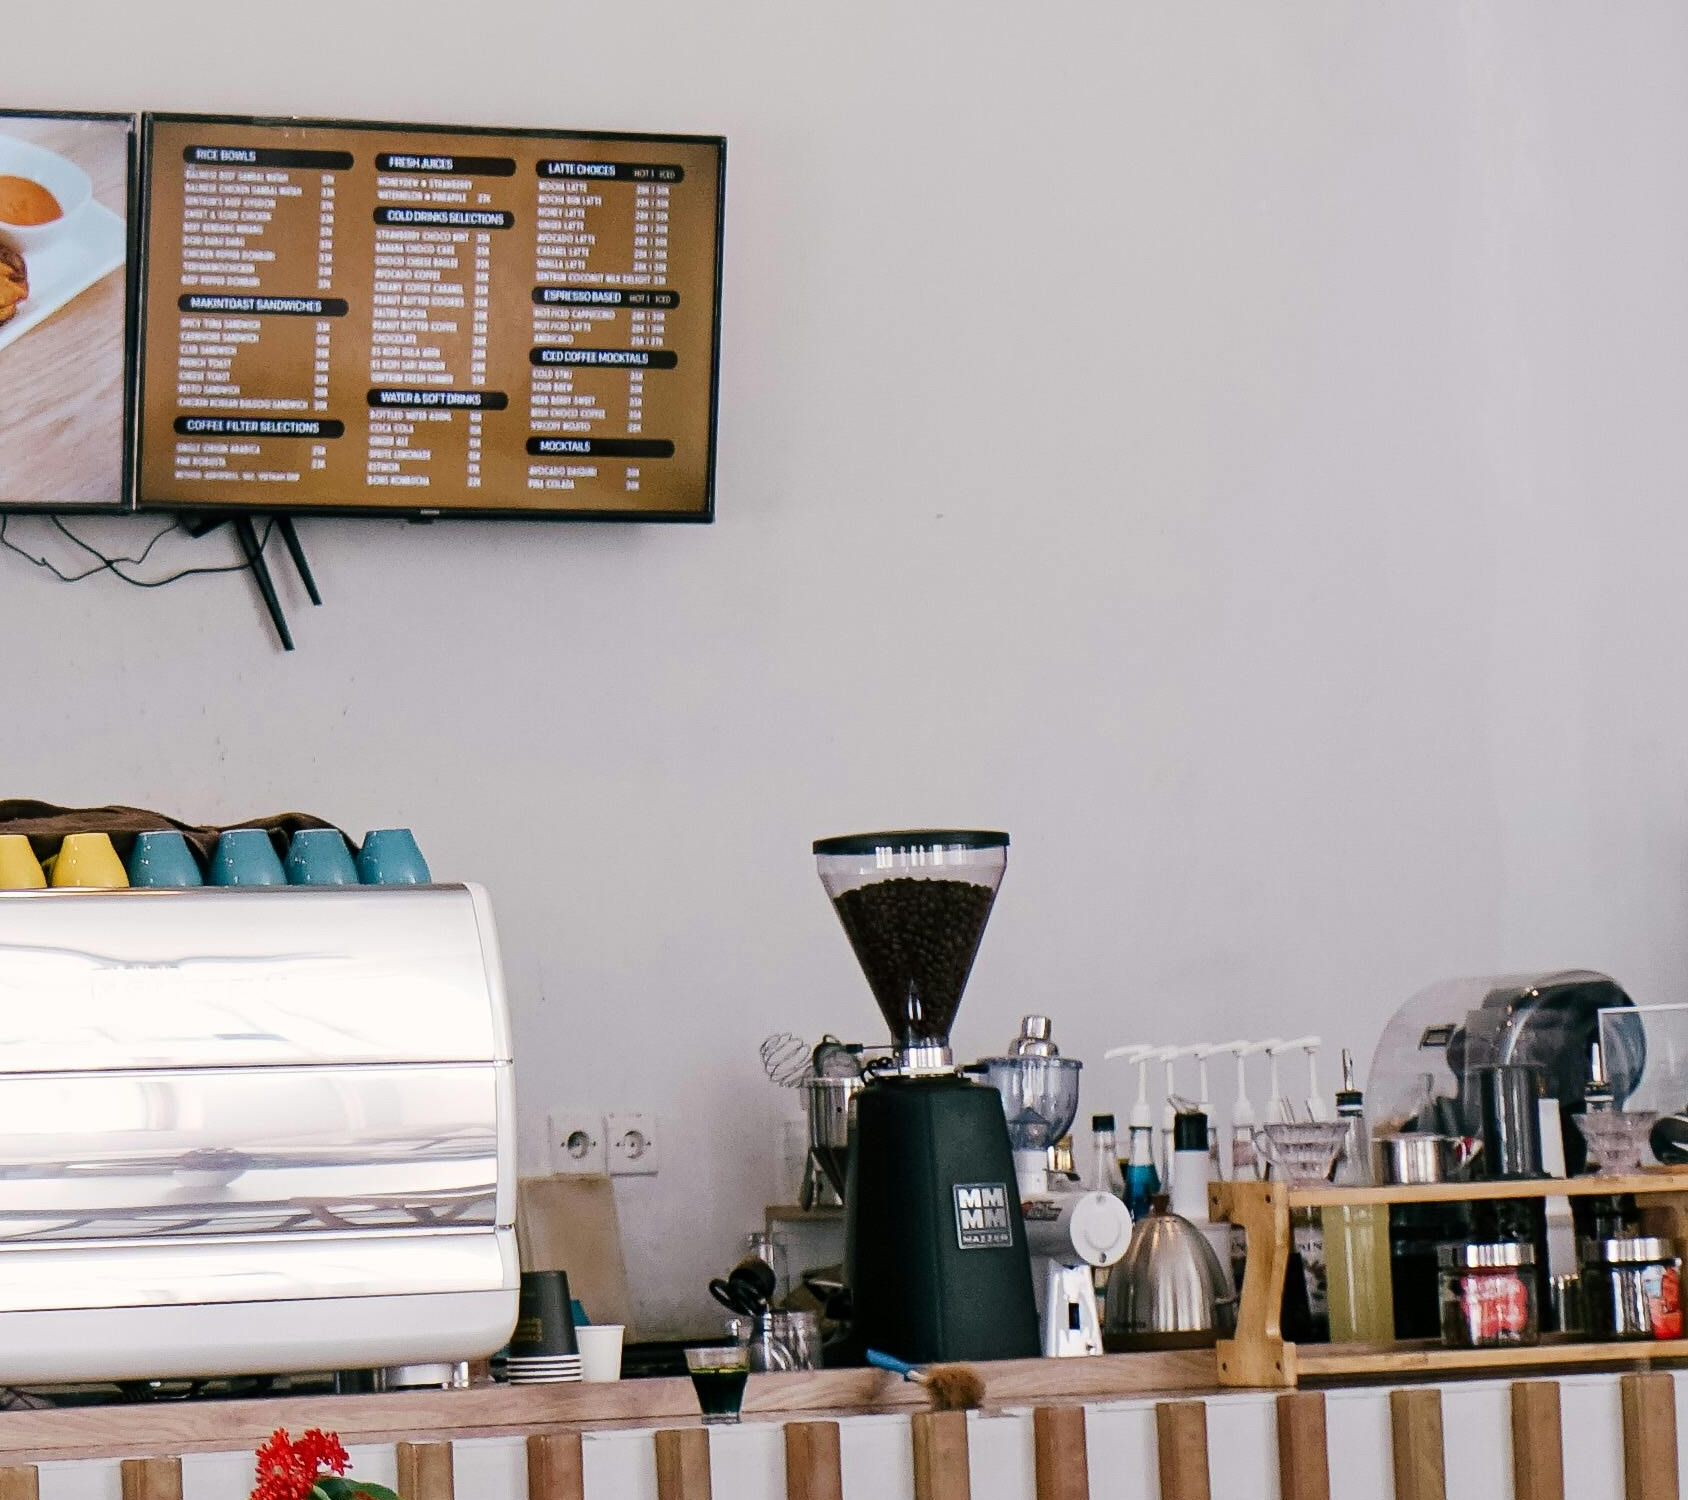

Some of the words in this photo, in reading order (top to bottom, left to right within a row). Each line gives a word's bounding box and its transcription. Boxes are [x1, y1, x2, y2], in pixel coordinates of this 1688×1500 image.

[194, 150, 218, 160] RICE
[220, 150, 256, 162] BOWLS
[388, 156, 420, 168] FRESH
[420, 158, 454, 170] JUICES
[548, 164, 574, 174] LATTE
[576, 164, 616, 176] CHOICES
[387, 210, 414, 222] COLD
[414, 212, 448, 222] DRINKS
[448, 212, 504, 224] SELECTIONS
[543, 290, 592, 302] ESPRESSO
[592, 292, 622, 302] BASED
[256, 300, 322, 312] SANDWICHES
[542, 350, 564, 362] ICED
[564, 352, 596, 362] COFFEE
[598, 352, 649, 364] MOCKTAILS
[380, 392, 413, 402] WATER
[413, 392, 422, 404] &
[422, 392, 446, 404] SOFT
[446, 392, 482, 406] DRINKS
[187, 420, 223, 430] COFFEE
[226, 420, 258, 432] FILTER
[260, 422, 320, 432] SELECTIONS
[540, 442, 591, 452] MOCKTAILS
